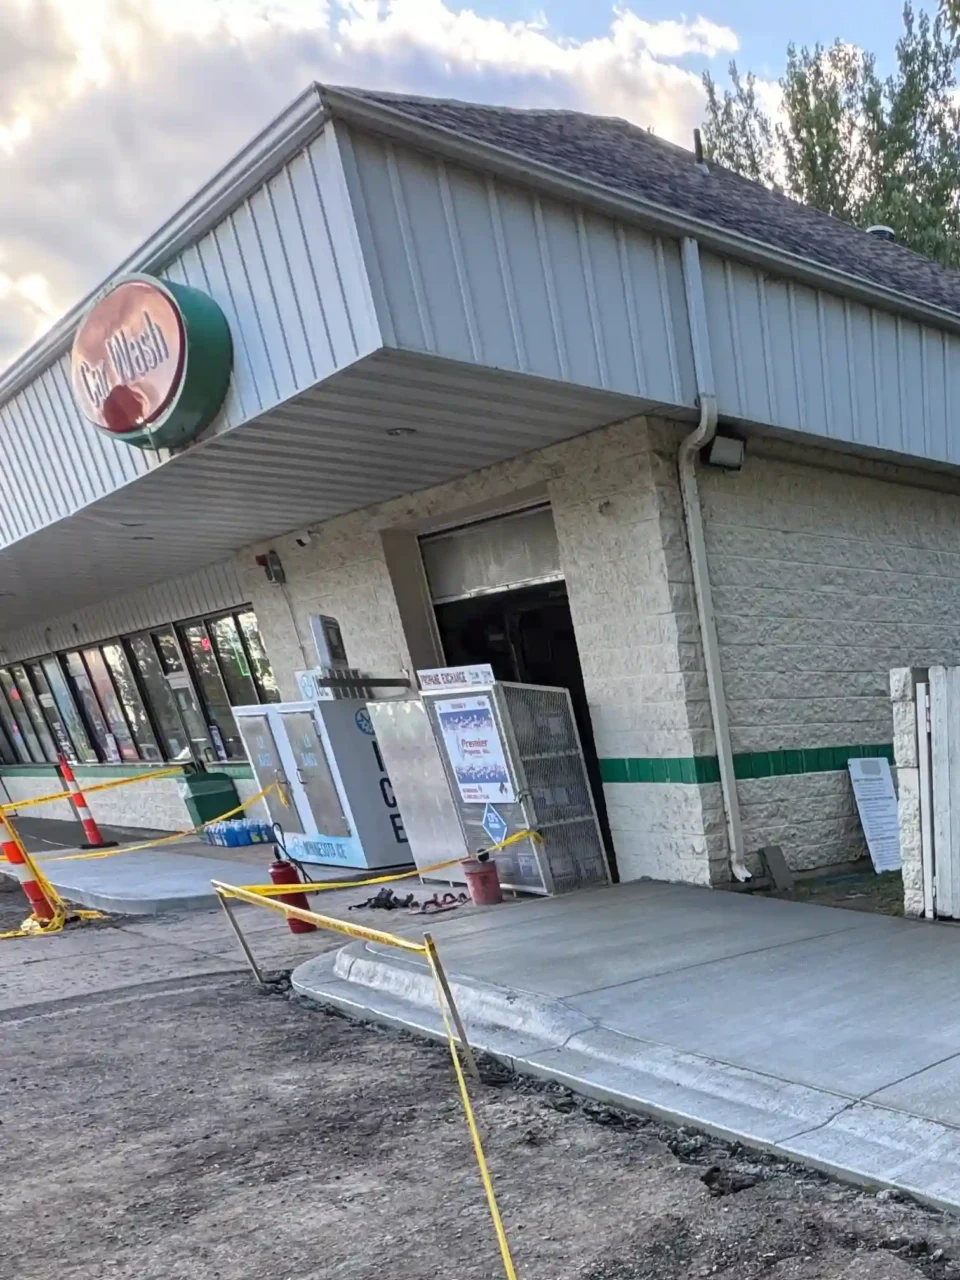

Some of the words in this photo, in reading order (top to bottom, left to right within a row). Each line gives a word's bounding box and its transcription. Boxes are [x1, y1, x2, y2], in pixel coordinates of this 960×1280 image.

[80, 359, 111, 408] Car
[105, 310, 169, 381] Wash
[461, 736, 488, 749] Premier
[303, 840, 337, 858] MINNESOTA
[336, 843, 348, 859] ICE
